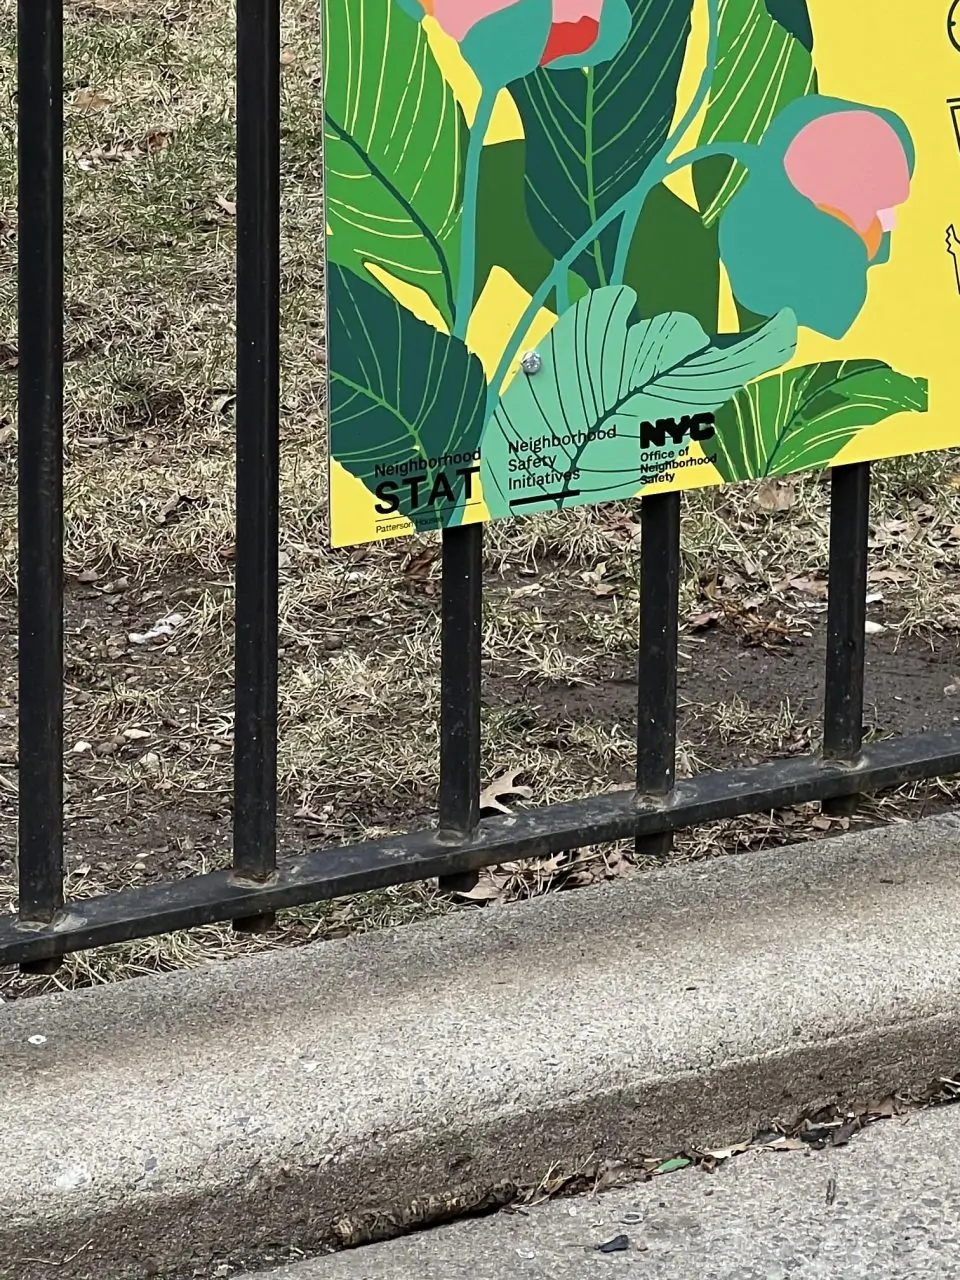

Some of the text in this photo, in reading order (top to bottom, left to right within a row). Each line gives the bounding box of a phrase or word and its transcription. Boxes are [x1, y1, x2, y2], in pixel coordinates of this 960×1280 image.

[508, 425, 616, 454] Neighborhood
[640, 412, 715, 449] NYC
[374, 447, 481, 478] Neighborhood
[508, 454, 557, 473] Safety
[640, 446, 690, 463] Office of
[640, 453, 717, 474] Neighborhood
[508, 469, 580, 490] Initiatives
[640, 471, 675, 485] Safety
[374, 466, 481, 514] STAT
[376, 521, 413, 533] Patterson
